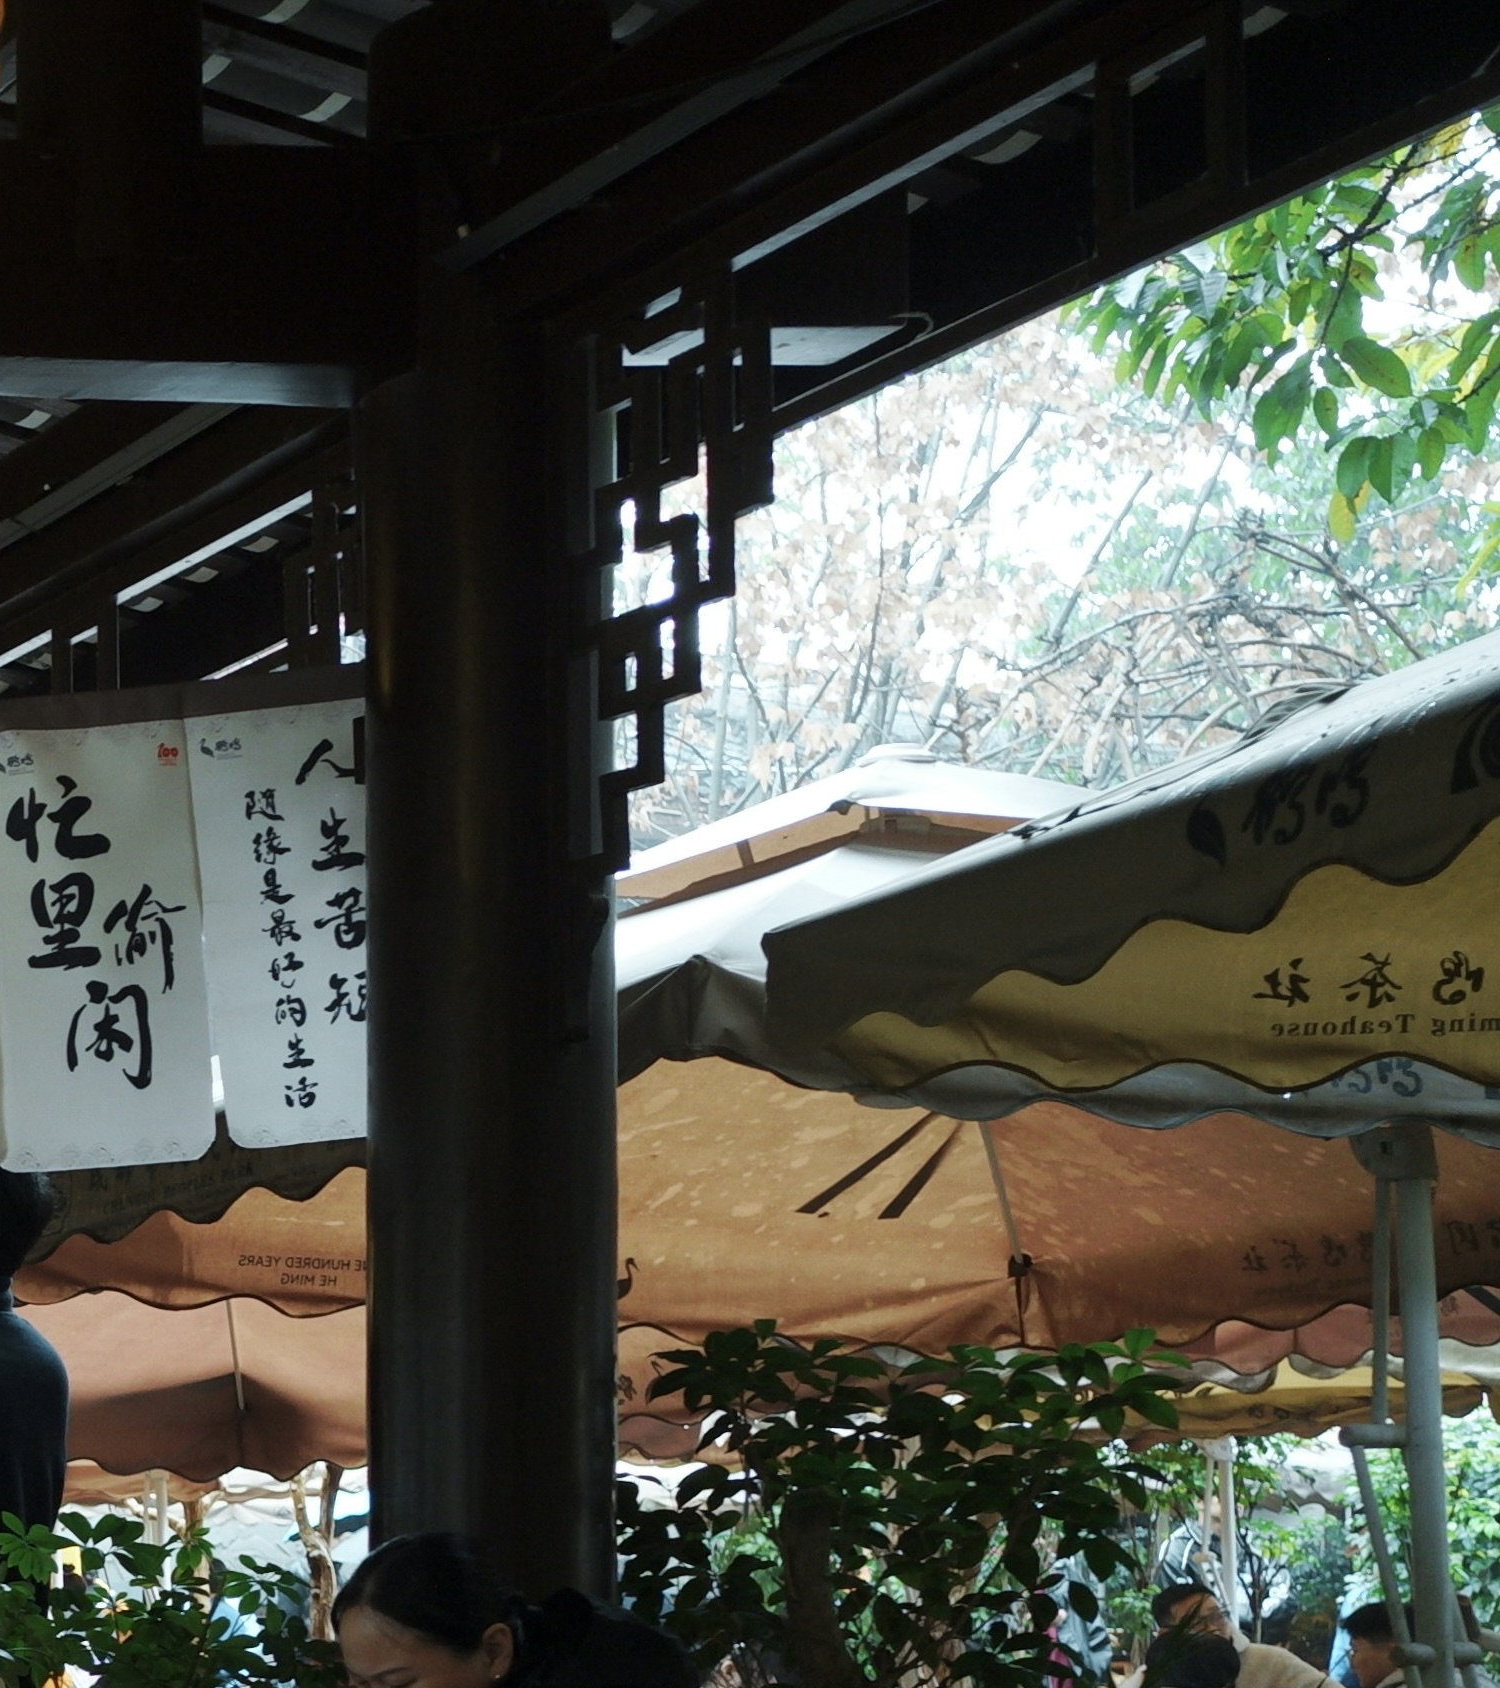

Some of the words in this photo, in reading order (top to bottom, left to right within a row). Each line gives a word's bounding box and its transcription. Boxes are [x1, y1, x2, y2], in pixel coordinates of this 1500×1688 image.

[7, 776, 185, 1089] 忙里偷闲
[244, 789, 319, 1109] 随缘是最好的生活
